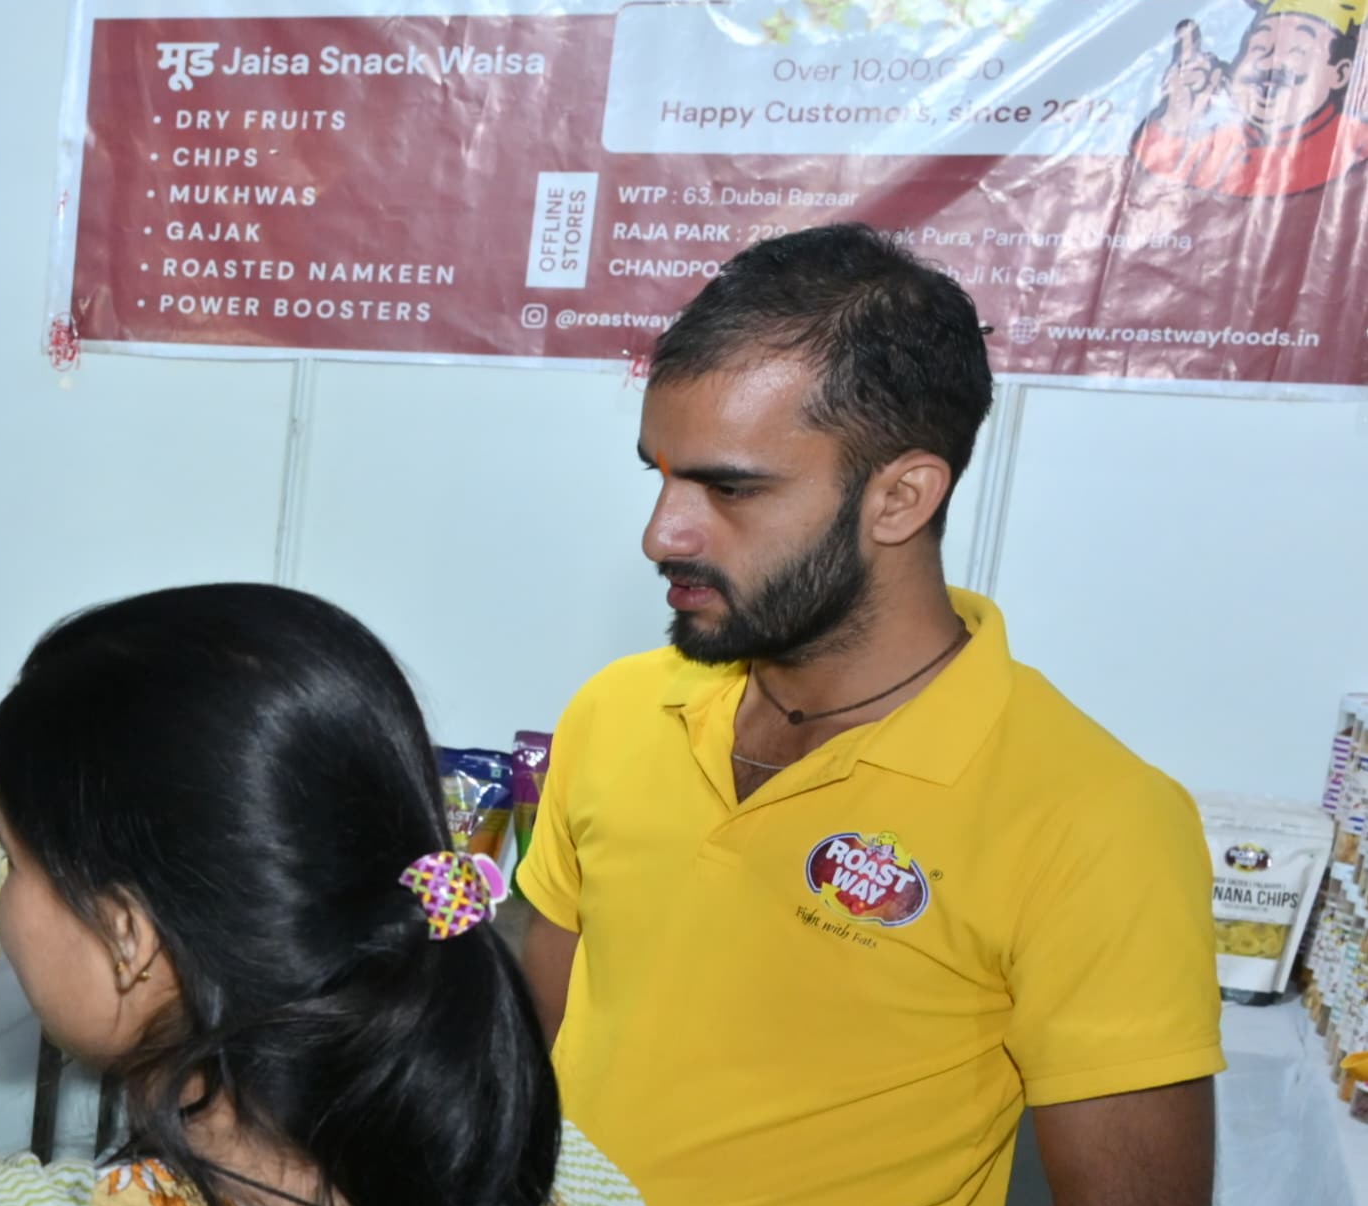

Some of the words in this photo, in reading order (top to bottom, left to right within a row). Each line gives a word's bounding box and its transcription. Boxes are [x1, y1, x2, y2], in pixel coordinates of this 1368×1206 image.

[156, 42, 220, 92] मूड
[222, 46, 310, 76] Jaisa
[319, 45, 427, 76] Snack
[438, 46, 546, 76] Waisa
[772, 57, 842, 82] Over
[175, 110, 231, 131] DRY
[243, 110, 347, 132] FRUITS
[660, 101, 754, 129] Happy
[764, 101, 939, 127] Customers,
[947, 99, 1031, 123] since
[172, 146, 259, 168] CHIPS
[169, 184, 317, 206] MUKHWAS
[618, 186, 668, 205] WTP
[682, 186, 715, 208] 63,
[720, 187, 782, 207] Dubai
[787, 187, 859, 208] Bazaar
[166, 221, 262, 243] GAJAK
[538, 187, 564, 273] OFFLINE
[561, 189, 586, 271] STORES
[613, 223, 669, 241] RAJA
[674, 223, 731, 242] PARK
[922, 228, 974, 249] Pura,
[163, 258, 295, 280] ROASTED
[308, 261, 455, 285] NAMKEEN
[609, 259, 723, 278] CHANDPO
[990, 267, 1010, 285] Ki
[159, 294, 261, 317] POWER
[273, 297, 432, 323] BOOSTERS
[1047, 323, 1320, 351] www.roastwayfoods.in
[826, 839, 916, 893] ROAST
[832, 866, 887, 905] WAY
[1213, 885, 1252, 905] NANA
[1256, 890, 1299, 909] CHIPS
[822, 918, 850, 940] with
